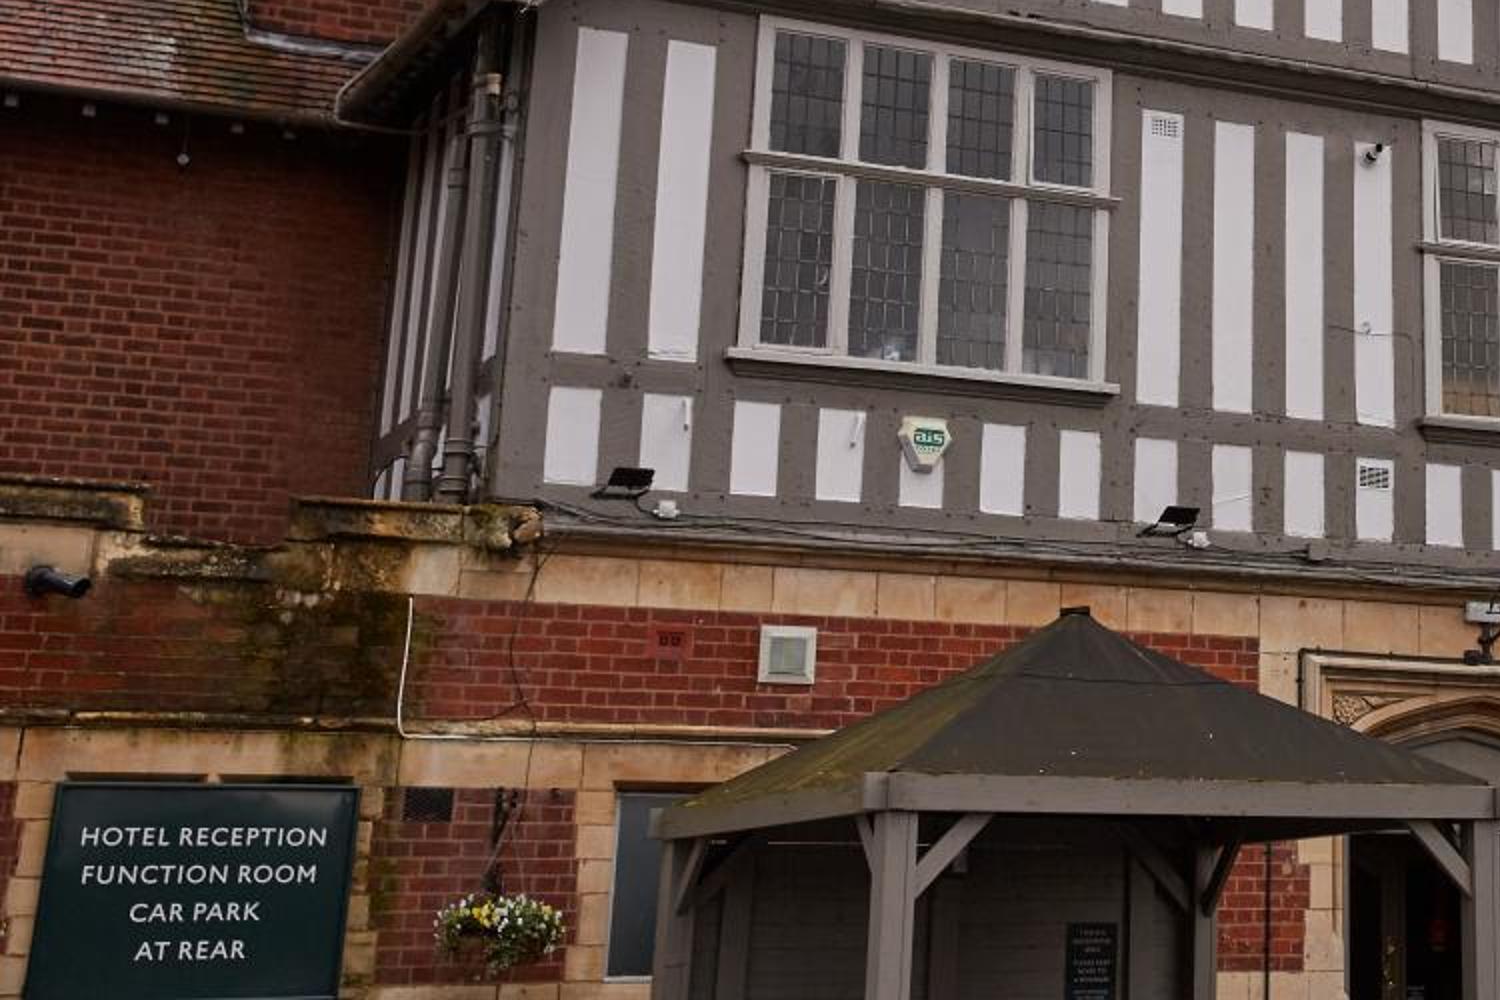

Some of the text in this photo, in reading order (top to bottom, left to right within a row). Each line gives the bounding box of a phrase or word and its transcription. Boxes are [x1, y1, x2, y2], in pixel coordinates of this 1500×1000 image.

[80, 826, 328, 847] HOTEL RECEPTION
[81, 864, 318, 885] FUNCTION ROOM
[129, 901, 261, 923] CAR PARK
[133, 939, 246, 961] AT REAR
